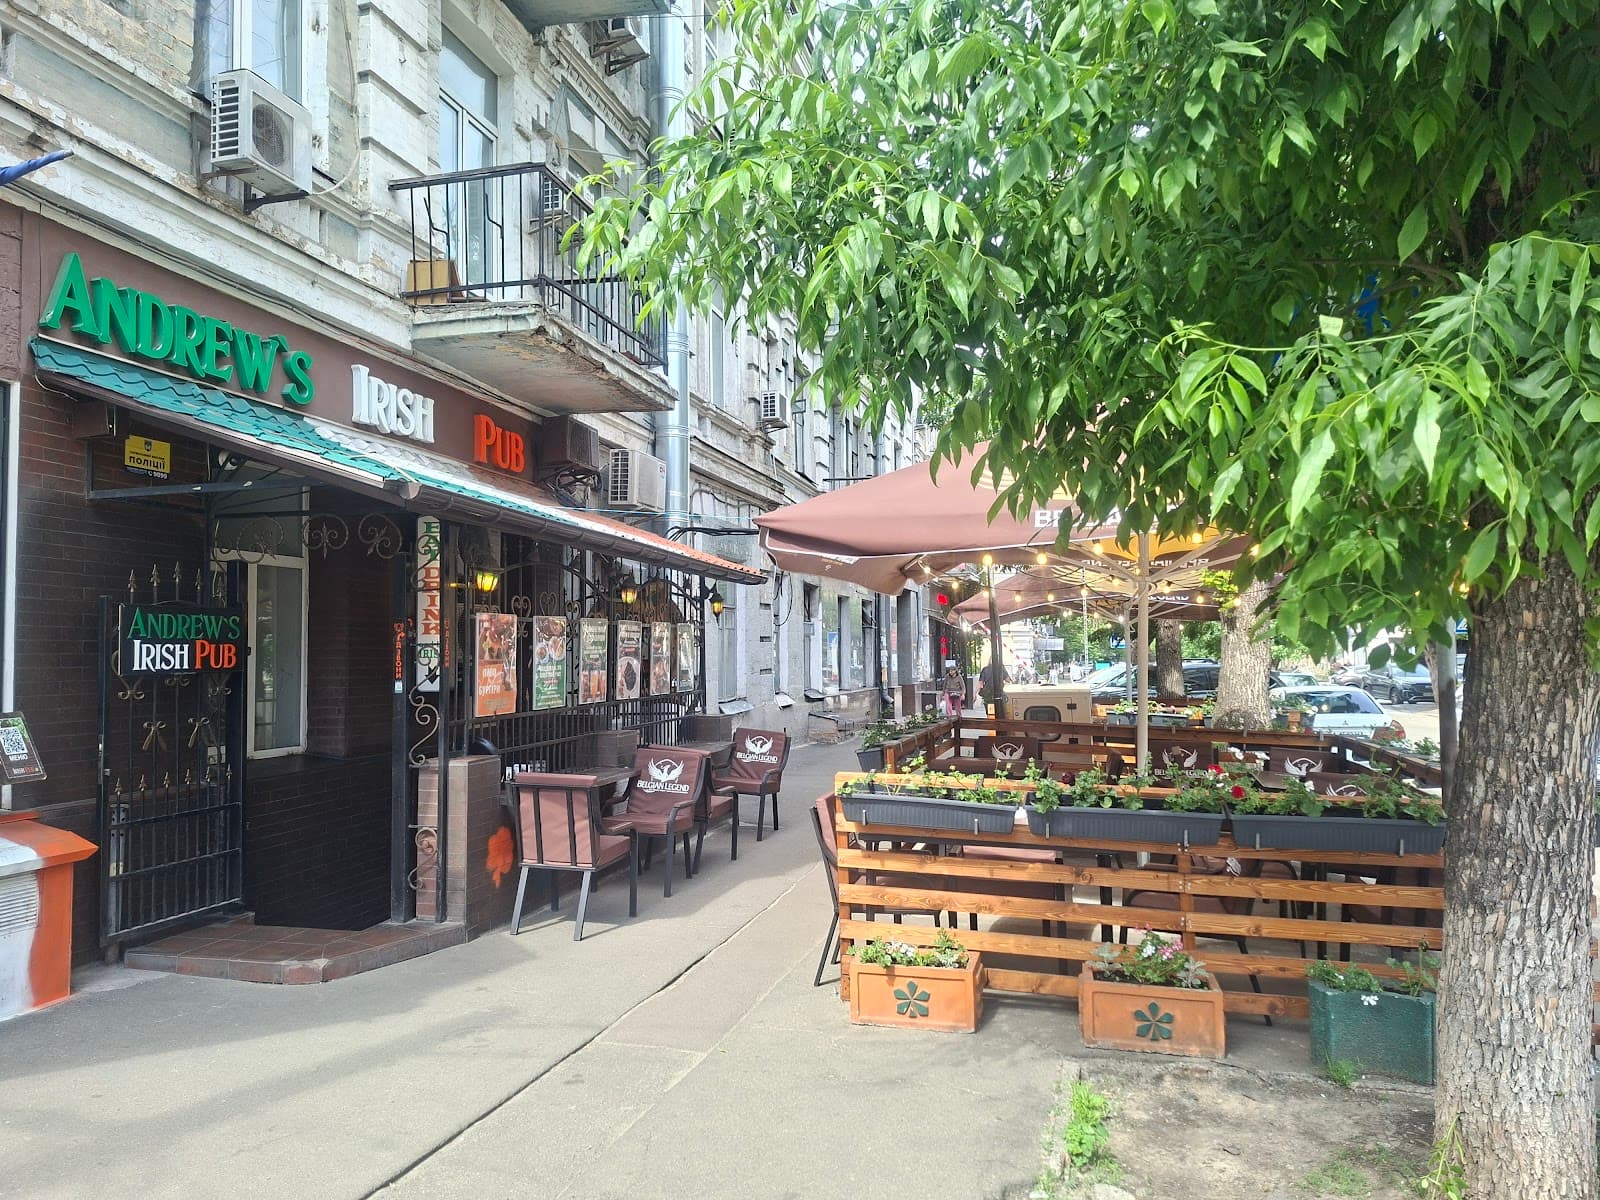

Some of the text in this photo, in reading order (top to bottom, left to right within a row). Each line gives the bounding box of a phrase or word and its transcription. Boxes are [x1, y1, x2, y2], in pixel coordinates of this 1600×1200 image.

[351, 364, 435, 443] IRISH
[474, 414, 525, 473] PUB
[127, 607, 240, 640] ANDREW'S
[132, 639, 237, 672] IRISH PUB
[736, 751, 759, 761] BELGIAN
[636, 779, 690, 792] BELGIAN LEGEND
